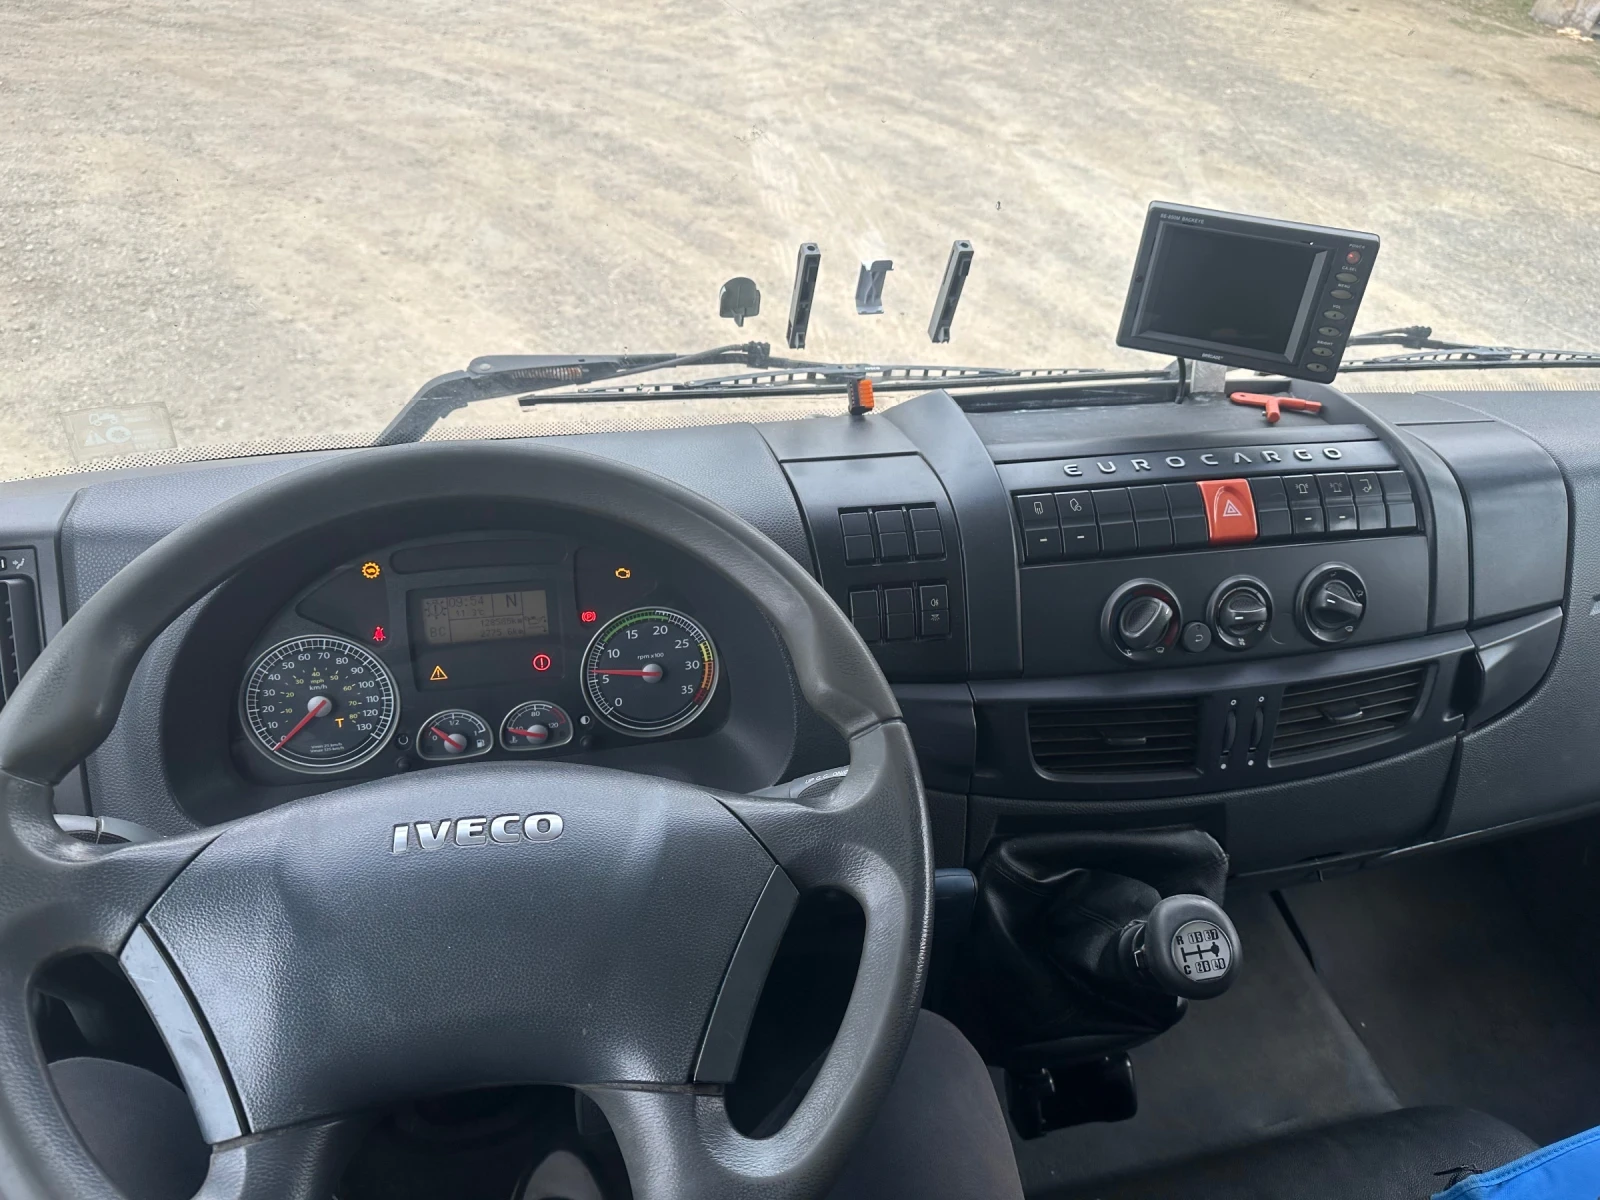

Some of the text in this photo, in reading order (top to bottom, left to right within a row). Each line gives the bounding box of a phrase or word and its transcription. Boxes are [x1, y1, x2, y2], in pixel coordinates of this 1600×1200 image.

[1063, 448, 1343, 476] EUROCARGO
[505, 593, 518, 609] N
[626, 630, 638, 640] 15
[653, 625, 668, 636] 20
[674, 639, 689, 649] 25
[298, 653, 311, 661] 60
[317, 652, 330, 660] 70
[607, 648, 620, 659] 10
[335, 656, 349, 665] 80
[685, 660, 700, 670] 30
[282, 661, 295, 670] 50
[350, 666, 364, 675] 90
[267, 673, 281, 681] 40
[602, 675, 610, 684] 5
[358, 681, 375, 689] 100
[263, 688, 276, 697] 30
[681, 685, 694, 695] 35
[366, 695, 380, 703] 110
[614, 698, 622, 707] 0
[262, 705, 275, 713] 20
[362, 709, 379, 717] 120
[268, 721, 279, 729] 10
[356, 723, 372, 731] 130
[392, 812, 565, 854] IVECO
[1175, 935, 1185, 946] R
[1183, 965, 1192, 975] C
